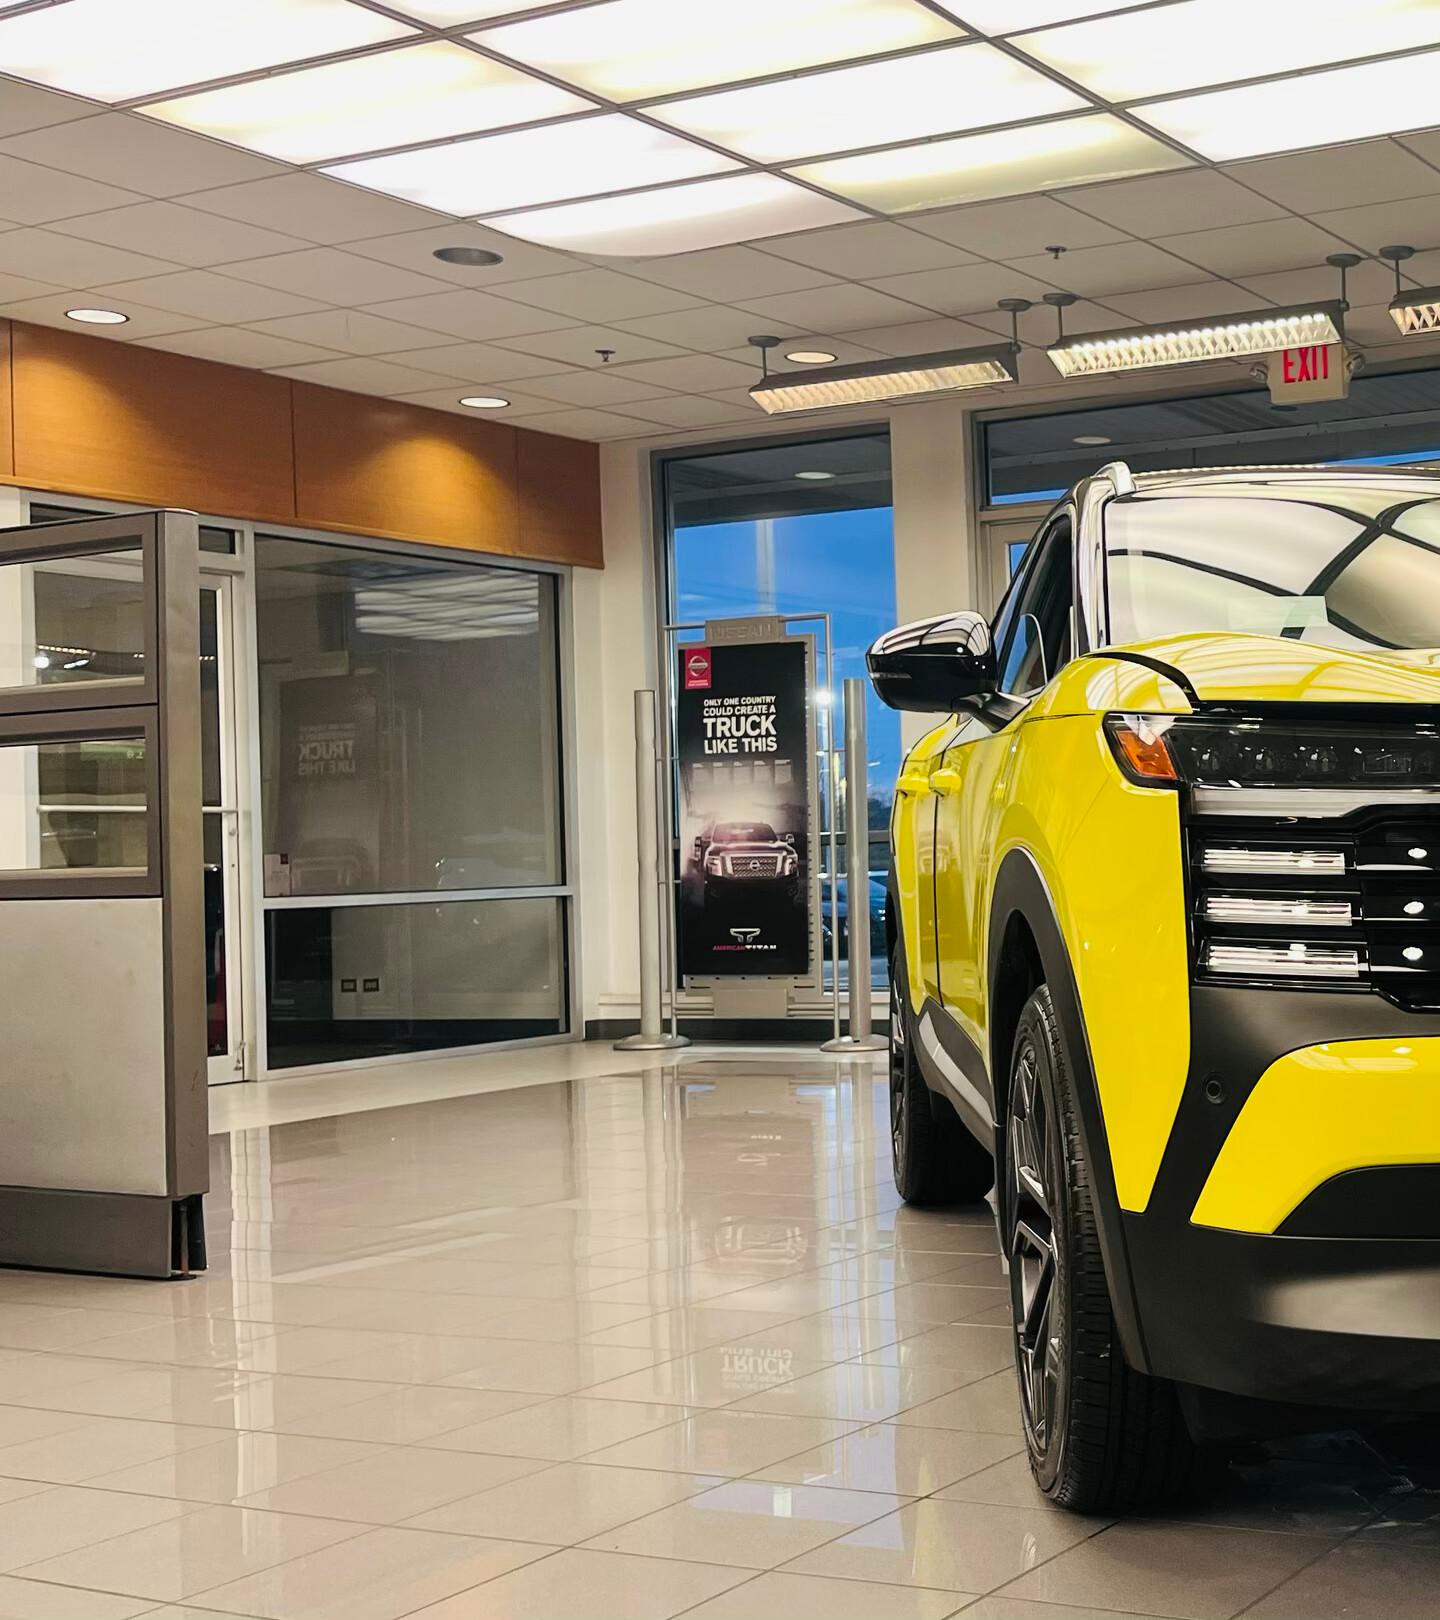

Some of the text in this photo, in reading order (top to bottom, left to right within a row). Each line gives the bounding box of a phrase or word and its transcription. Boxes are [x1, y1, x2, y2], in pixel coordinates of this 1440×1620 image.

[1283, 345, 1328, 383] EXIT
[703, 695, 776, 707] ONLY ONE COUNTRY
[703, 704, 776, 716] COULD CREATE A
[703, 715, 777, 738] TRUCK
[704, 736, 777, 754] LIKE THIS
